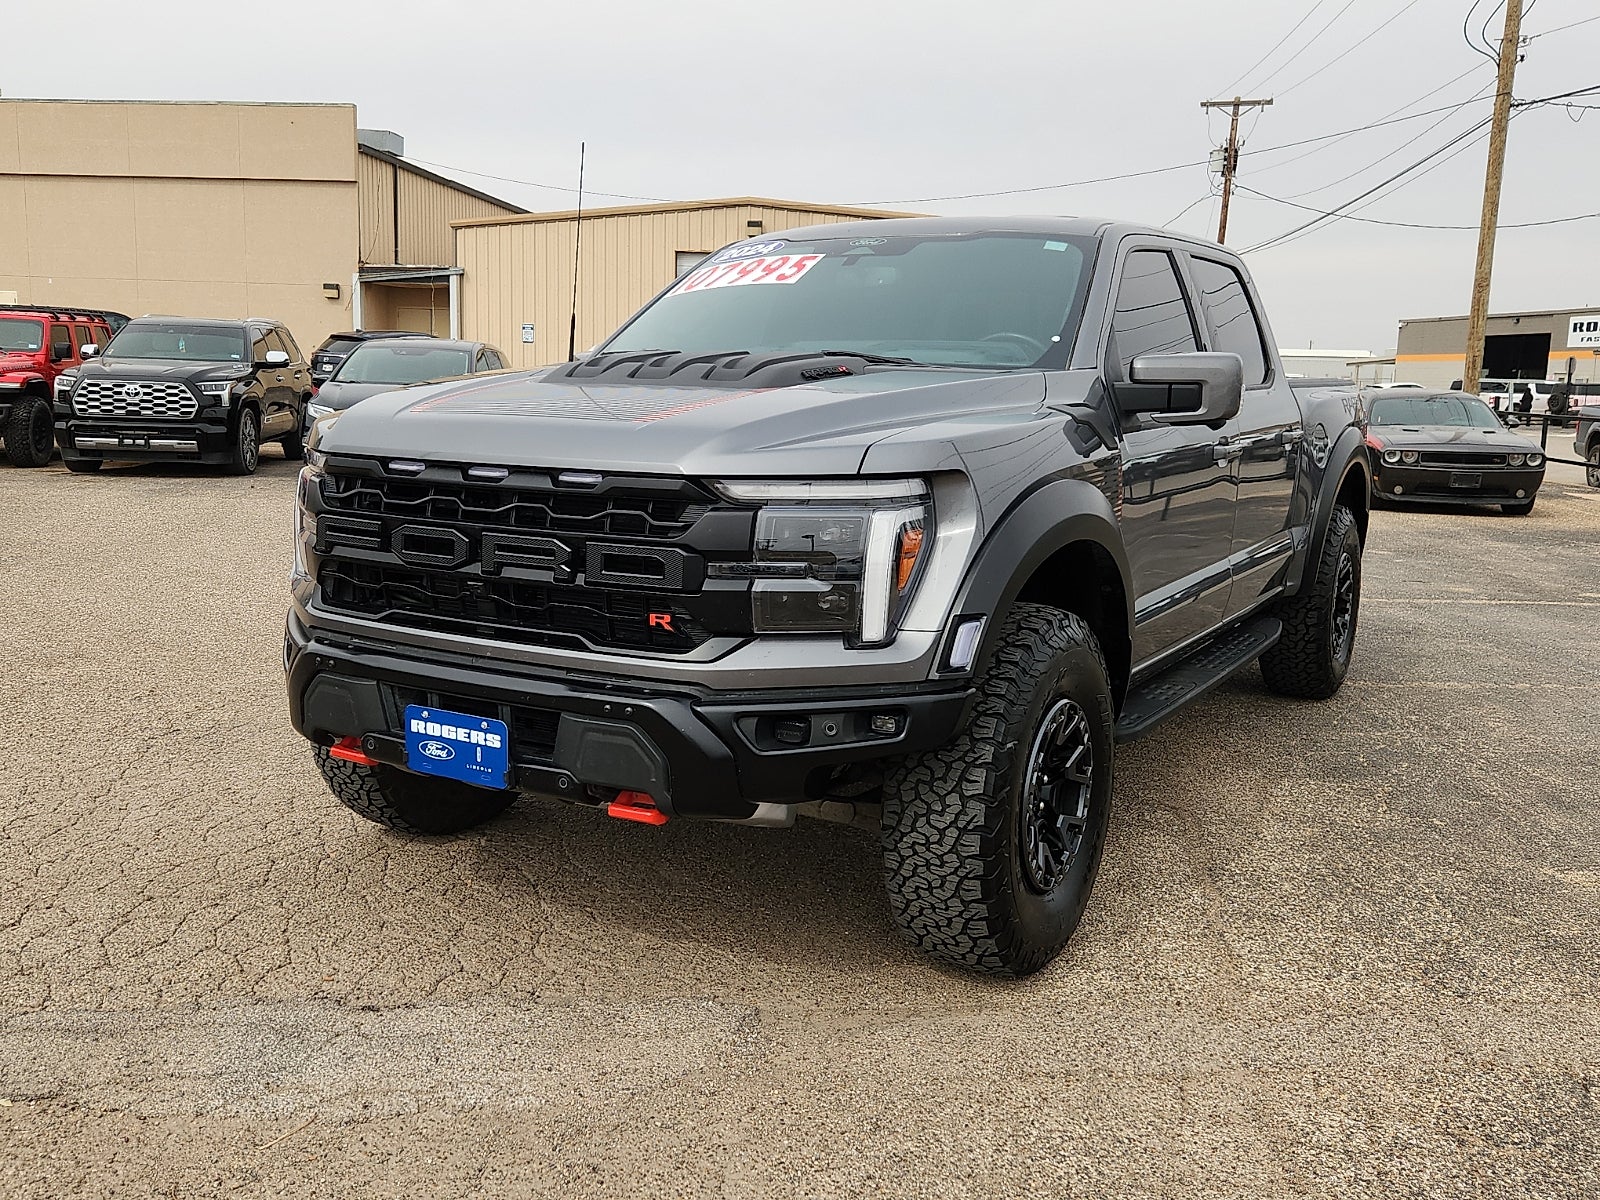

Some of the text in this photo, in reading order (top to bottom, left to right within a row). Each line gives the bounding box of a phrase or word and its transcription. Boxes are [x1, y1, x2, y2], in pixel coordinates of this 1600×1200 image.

[714, 242, 777, 261] 2024
[671, 255, 820, 296] 107995
[1573, 322, 1600, 333] RO
[315, 514, 686, 590] FORD
[649, 613, 675, 633] R
[410, 719, 501, 749] ROGERS
[425, 742, 449, 758] Ford
